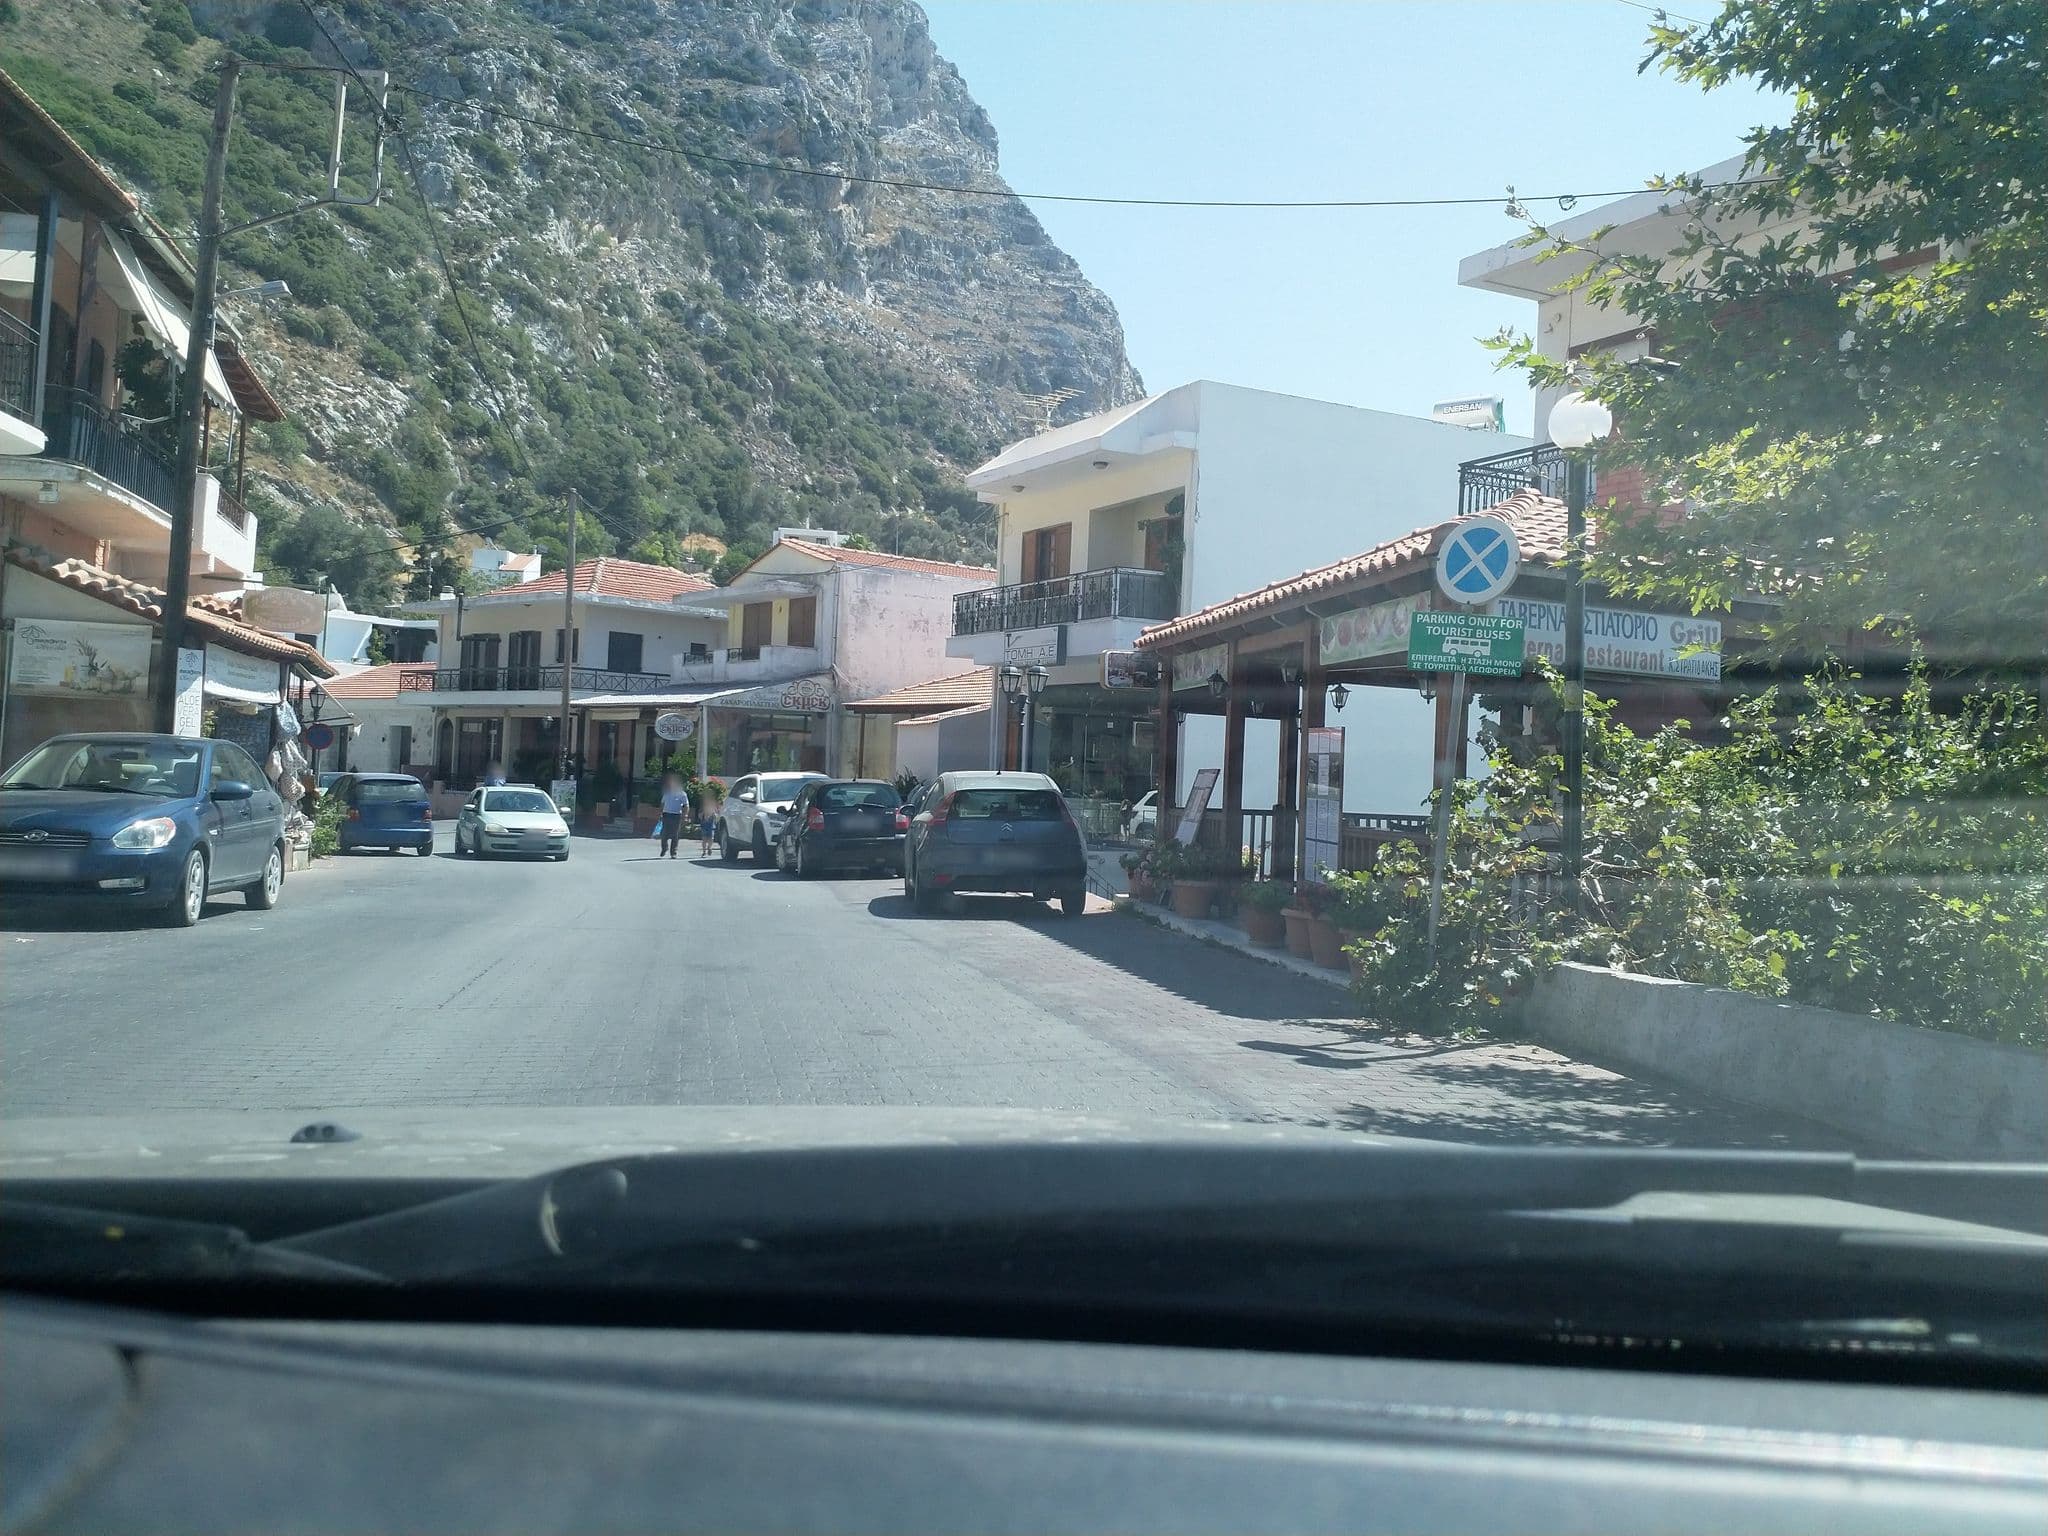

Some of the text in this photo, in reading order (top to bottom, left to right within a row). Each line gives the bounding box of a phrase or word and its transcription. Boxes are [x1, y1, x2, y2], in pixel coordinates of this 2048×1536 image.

[1443, 402, 1482, 414] ENERSAN
[1416, 614, 1523, 629] PARKING ONLY FOR
[1499, 600, 1658, 641] ΤΑΒΕΡΝΑ ΣΤΙΑΤΟΡΙΟ
[1426, 626, 1511, 640] TOURIST BUSES
[1670, 621, 1718, 646] Grill
[1467, 657, 1492, 666] ΣΤΑΣΗ
[1494, 659, 1521, 668] ΜΟΝΟ
[1526, 640, 1665, 672] erna estaurant
[1412, 661, 1421, 669] ΣΕ
[1468, 666, 1516, 675] ΛΕΩΦΟΡΕΙΑ
[179, 717, 196, 727] GEL
